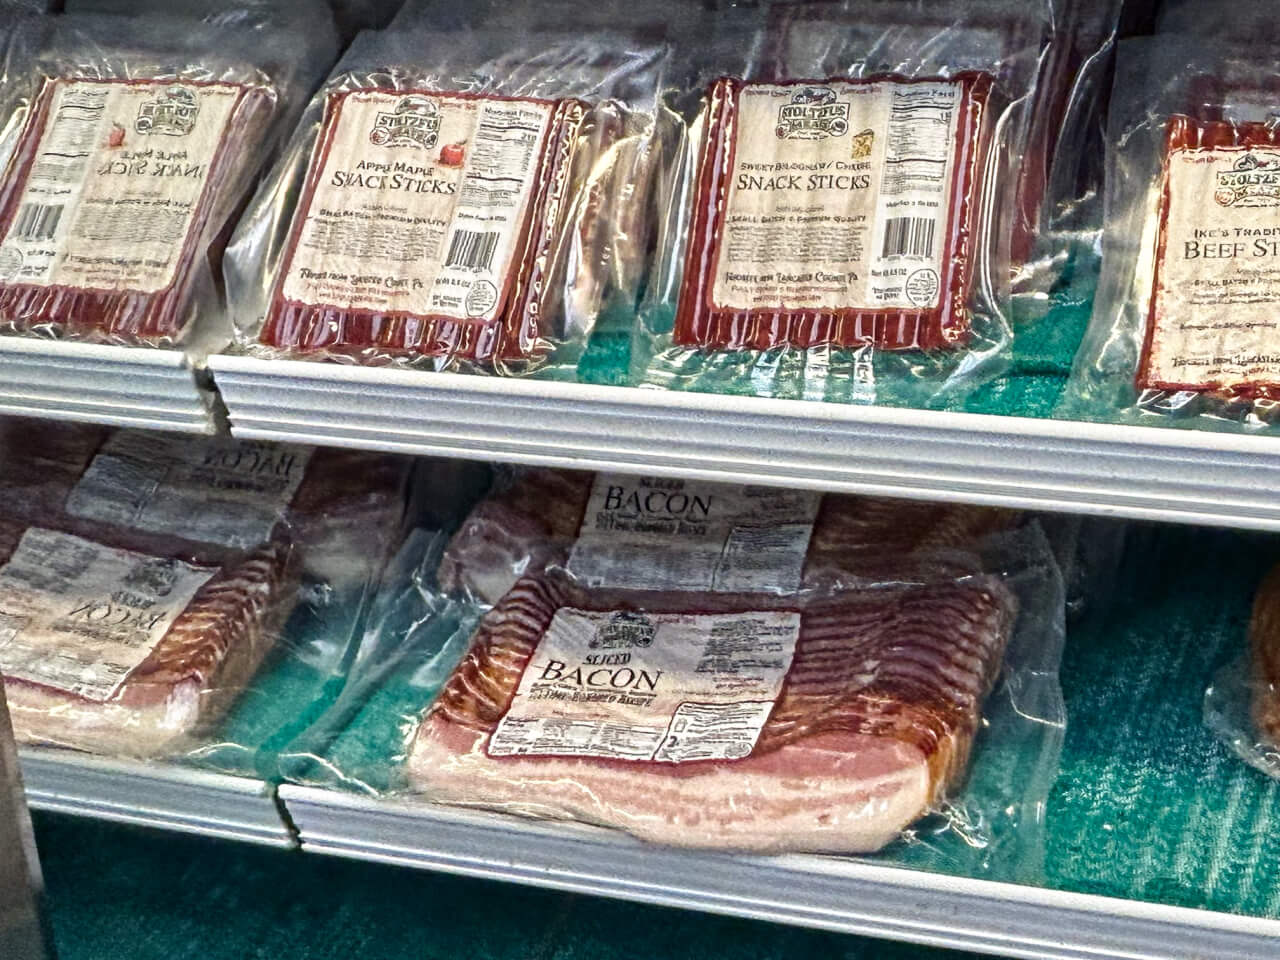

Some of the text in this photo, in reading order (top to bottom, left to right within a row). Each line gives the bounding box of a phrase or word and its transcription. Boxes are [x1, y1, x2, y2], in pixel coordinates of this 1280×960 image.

[389, 173, 457, 195] STICKS
[736, 173, 871, 192] SNACK STICKS
[1184, 240, 1247, 260] BEEF
[604, 485, 713, 516] BACON
[538, 658, 666, 691] BACON
